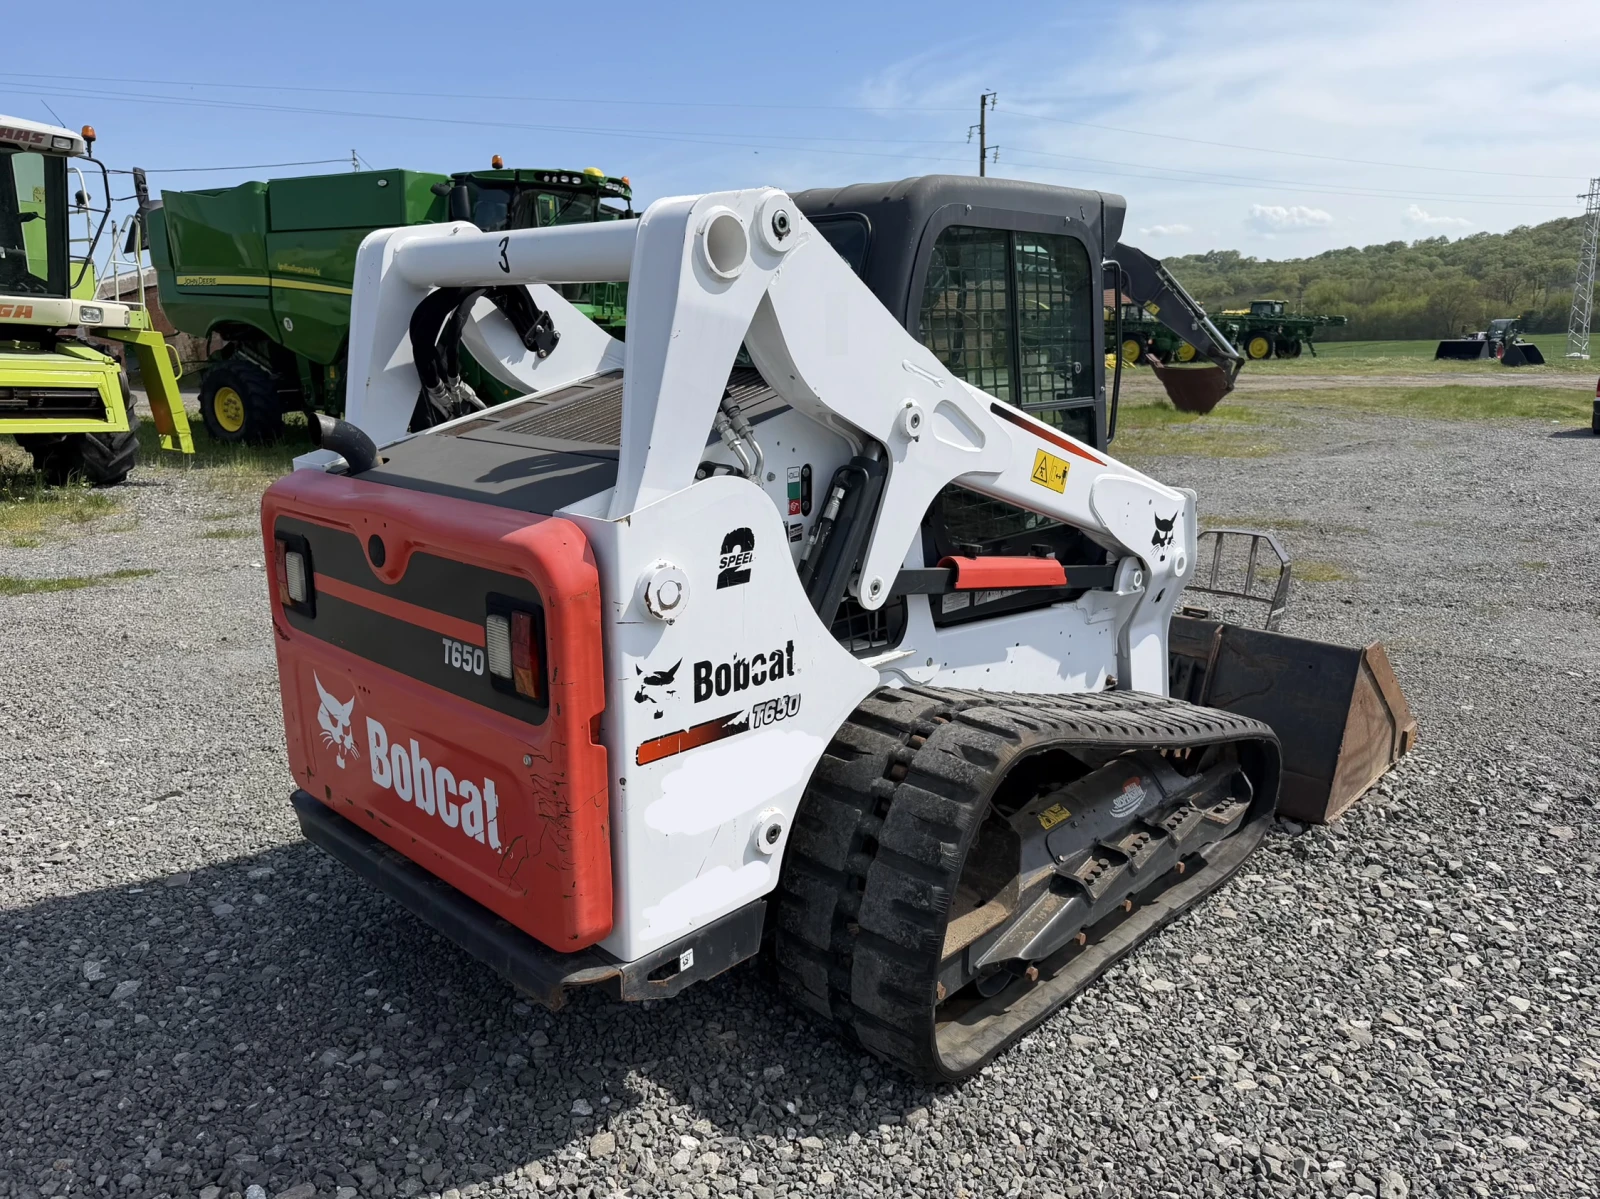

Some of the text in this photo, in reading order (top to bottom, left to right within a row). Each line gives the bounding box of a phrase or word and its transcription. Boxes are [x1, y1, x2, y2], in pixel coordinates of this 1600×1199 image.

[498, 236, 510, 274] 3
[183, 276, 216, 286] JOHN DEERE
[442, 637, 485, 676] T650
[693, 639, 795, 704] Bobcat
[752, 693, 801, 729] T650
[366, 715, 502, 855] Bobcat
